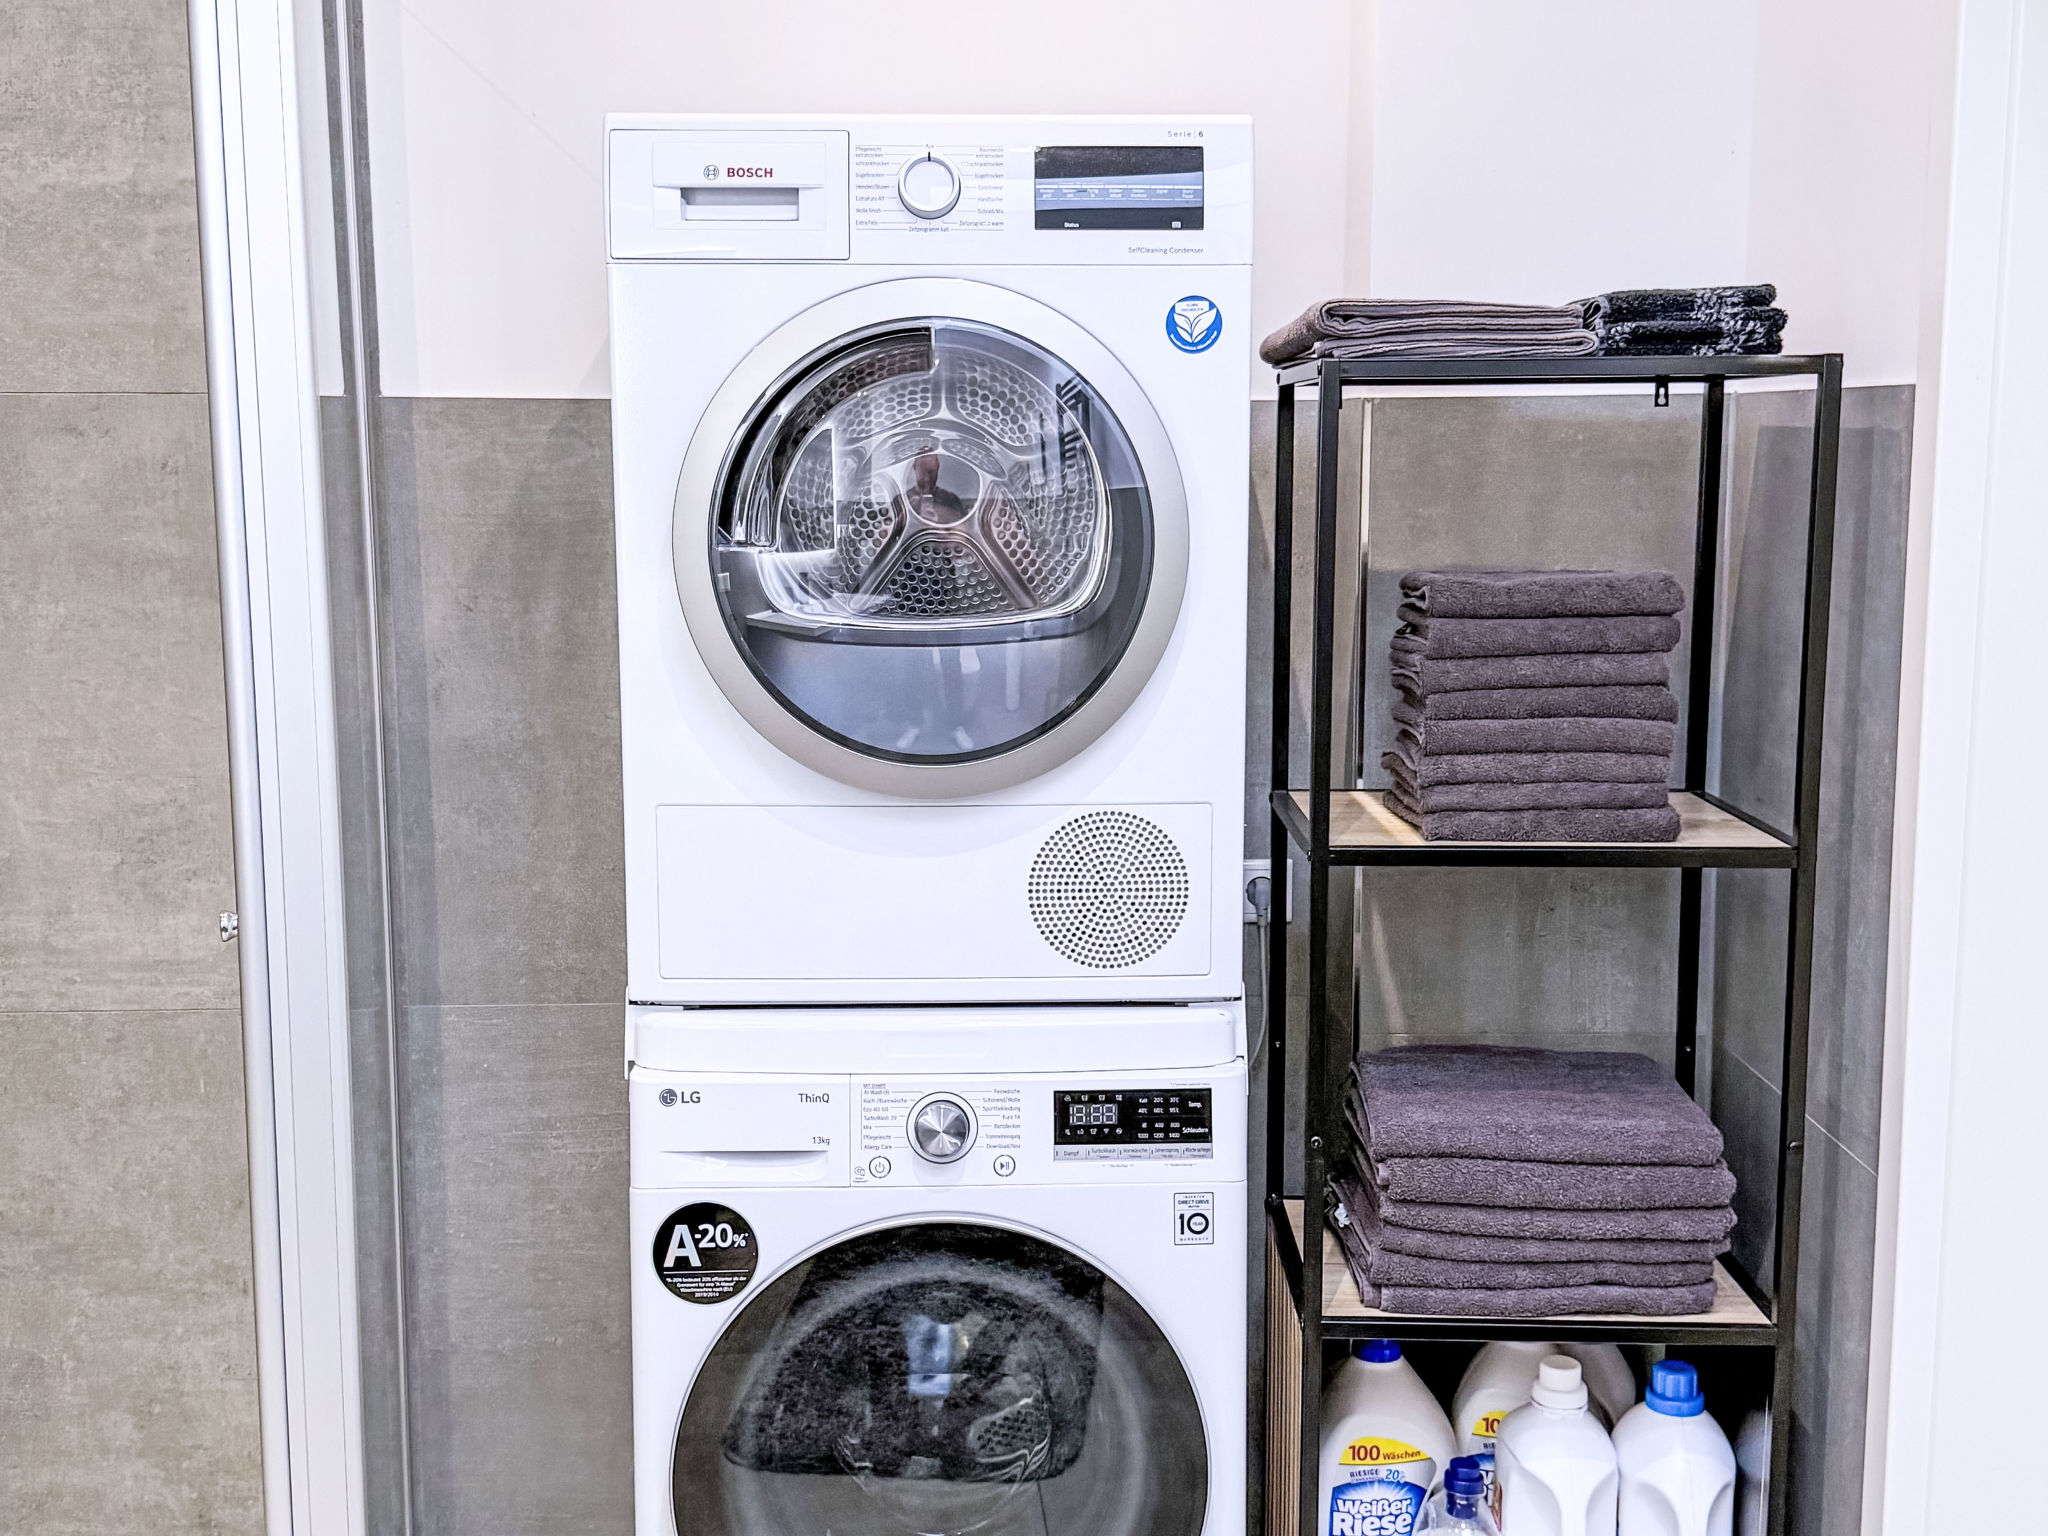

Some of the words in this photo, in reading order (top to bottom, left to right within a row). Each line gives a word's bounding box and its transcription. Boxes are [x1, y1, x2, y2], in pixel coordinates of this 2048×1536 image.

[727, 168, 773, 178] BOSCH
[681, 1091, 701, 1104] LG
[798, 1093, 830, 1103] ThinQ
[812, 1136, 830, 1146] 13kg
[1179, 1212, 1209, 1235] 10
[1348, 1445, 1380, 1461] 100
[1383, 1450, 1421, 1460] Wäschen
[1350, 1469, 1379, 1478] RIESIGE
[1336, 1499, 1412, 1516] Weißer
[1332, 1512, 1412, 1536] Riese
